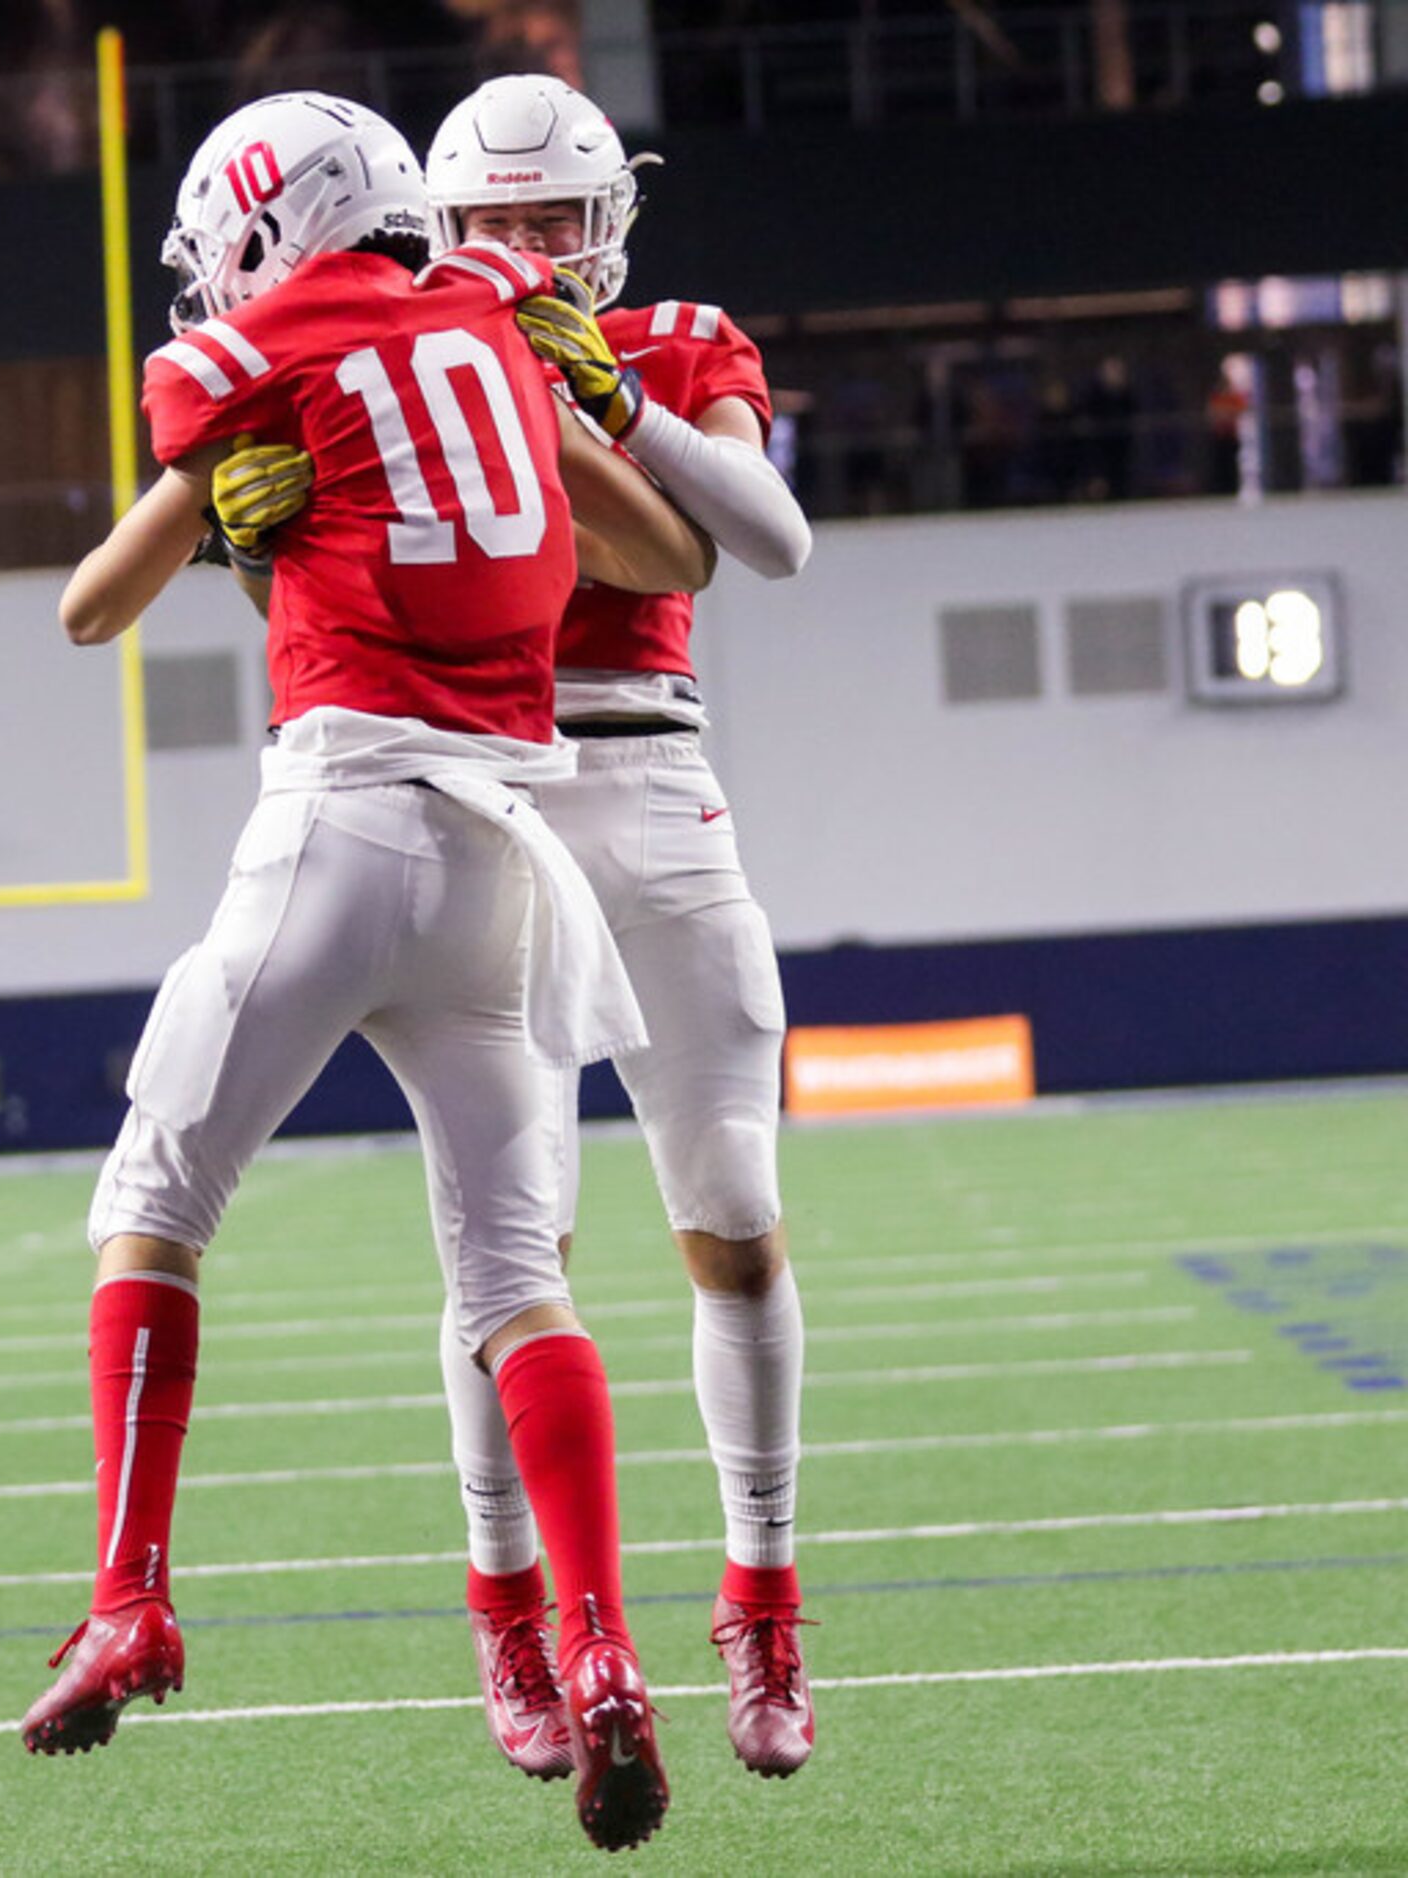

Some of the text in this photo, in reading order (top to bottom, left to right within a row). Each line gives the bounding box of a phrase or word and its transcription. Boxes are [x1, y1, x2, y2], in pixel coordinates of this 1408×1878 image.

[224, 140, 284, 214] 10
[487, 172, 542, 184] Riddell
[335, 329, 545, 564] 10
